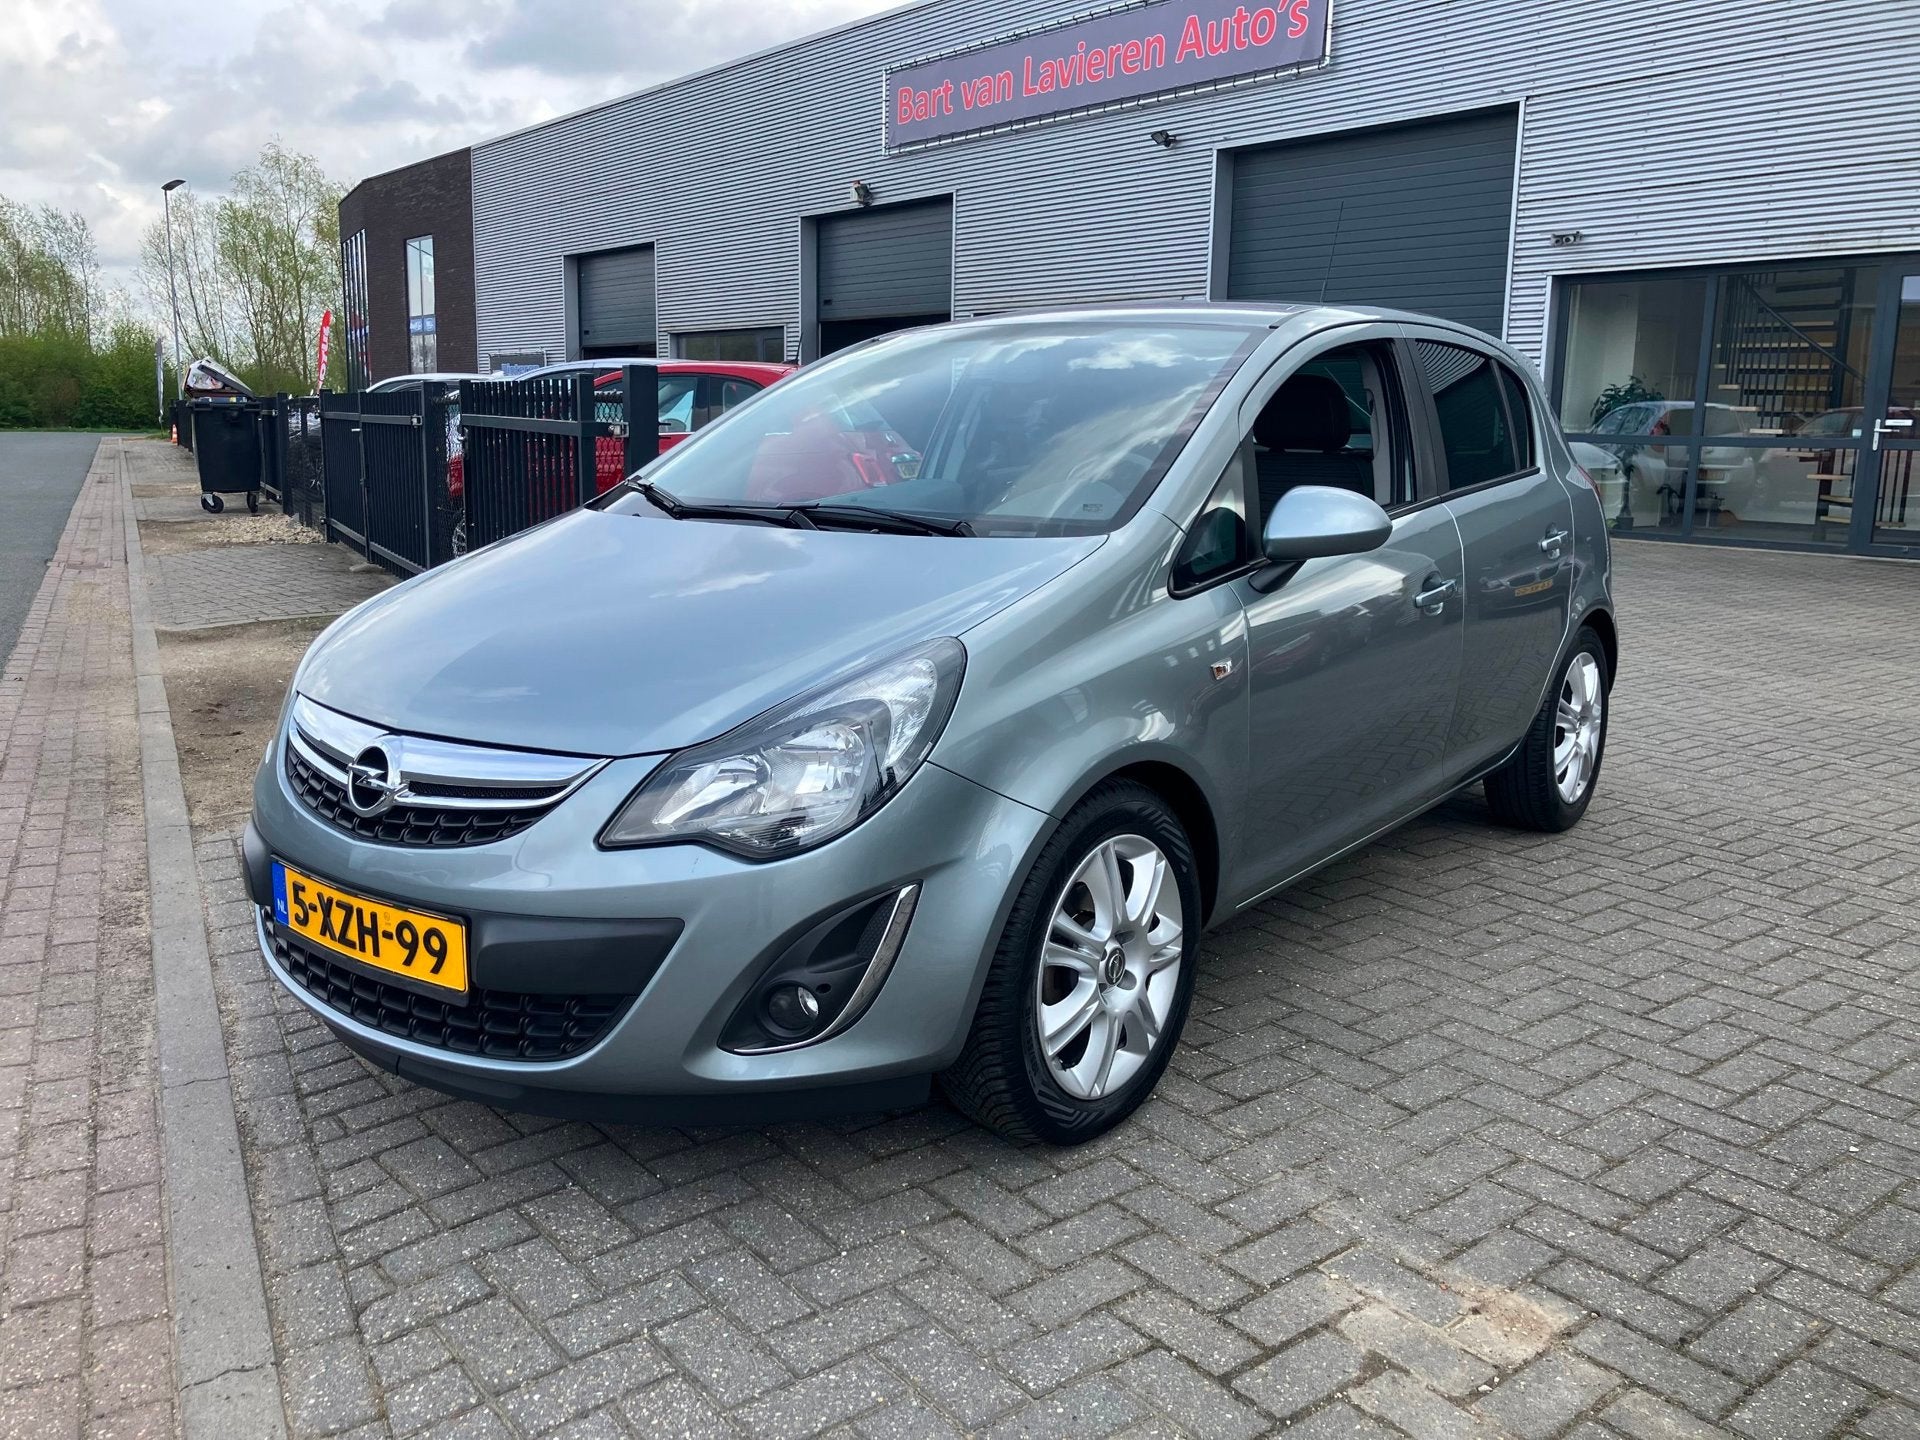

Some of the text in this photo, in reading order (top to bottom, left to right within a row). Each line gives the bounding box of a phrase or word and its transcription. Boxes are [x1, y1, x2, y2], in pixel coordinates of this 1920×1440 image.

[898, 0, 1310, 124] Bart van Lavieren Auto's
[277, 898, 287, 914] NL
[292, 882, 447, 975] 5-XZH-99
